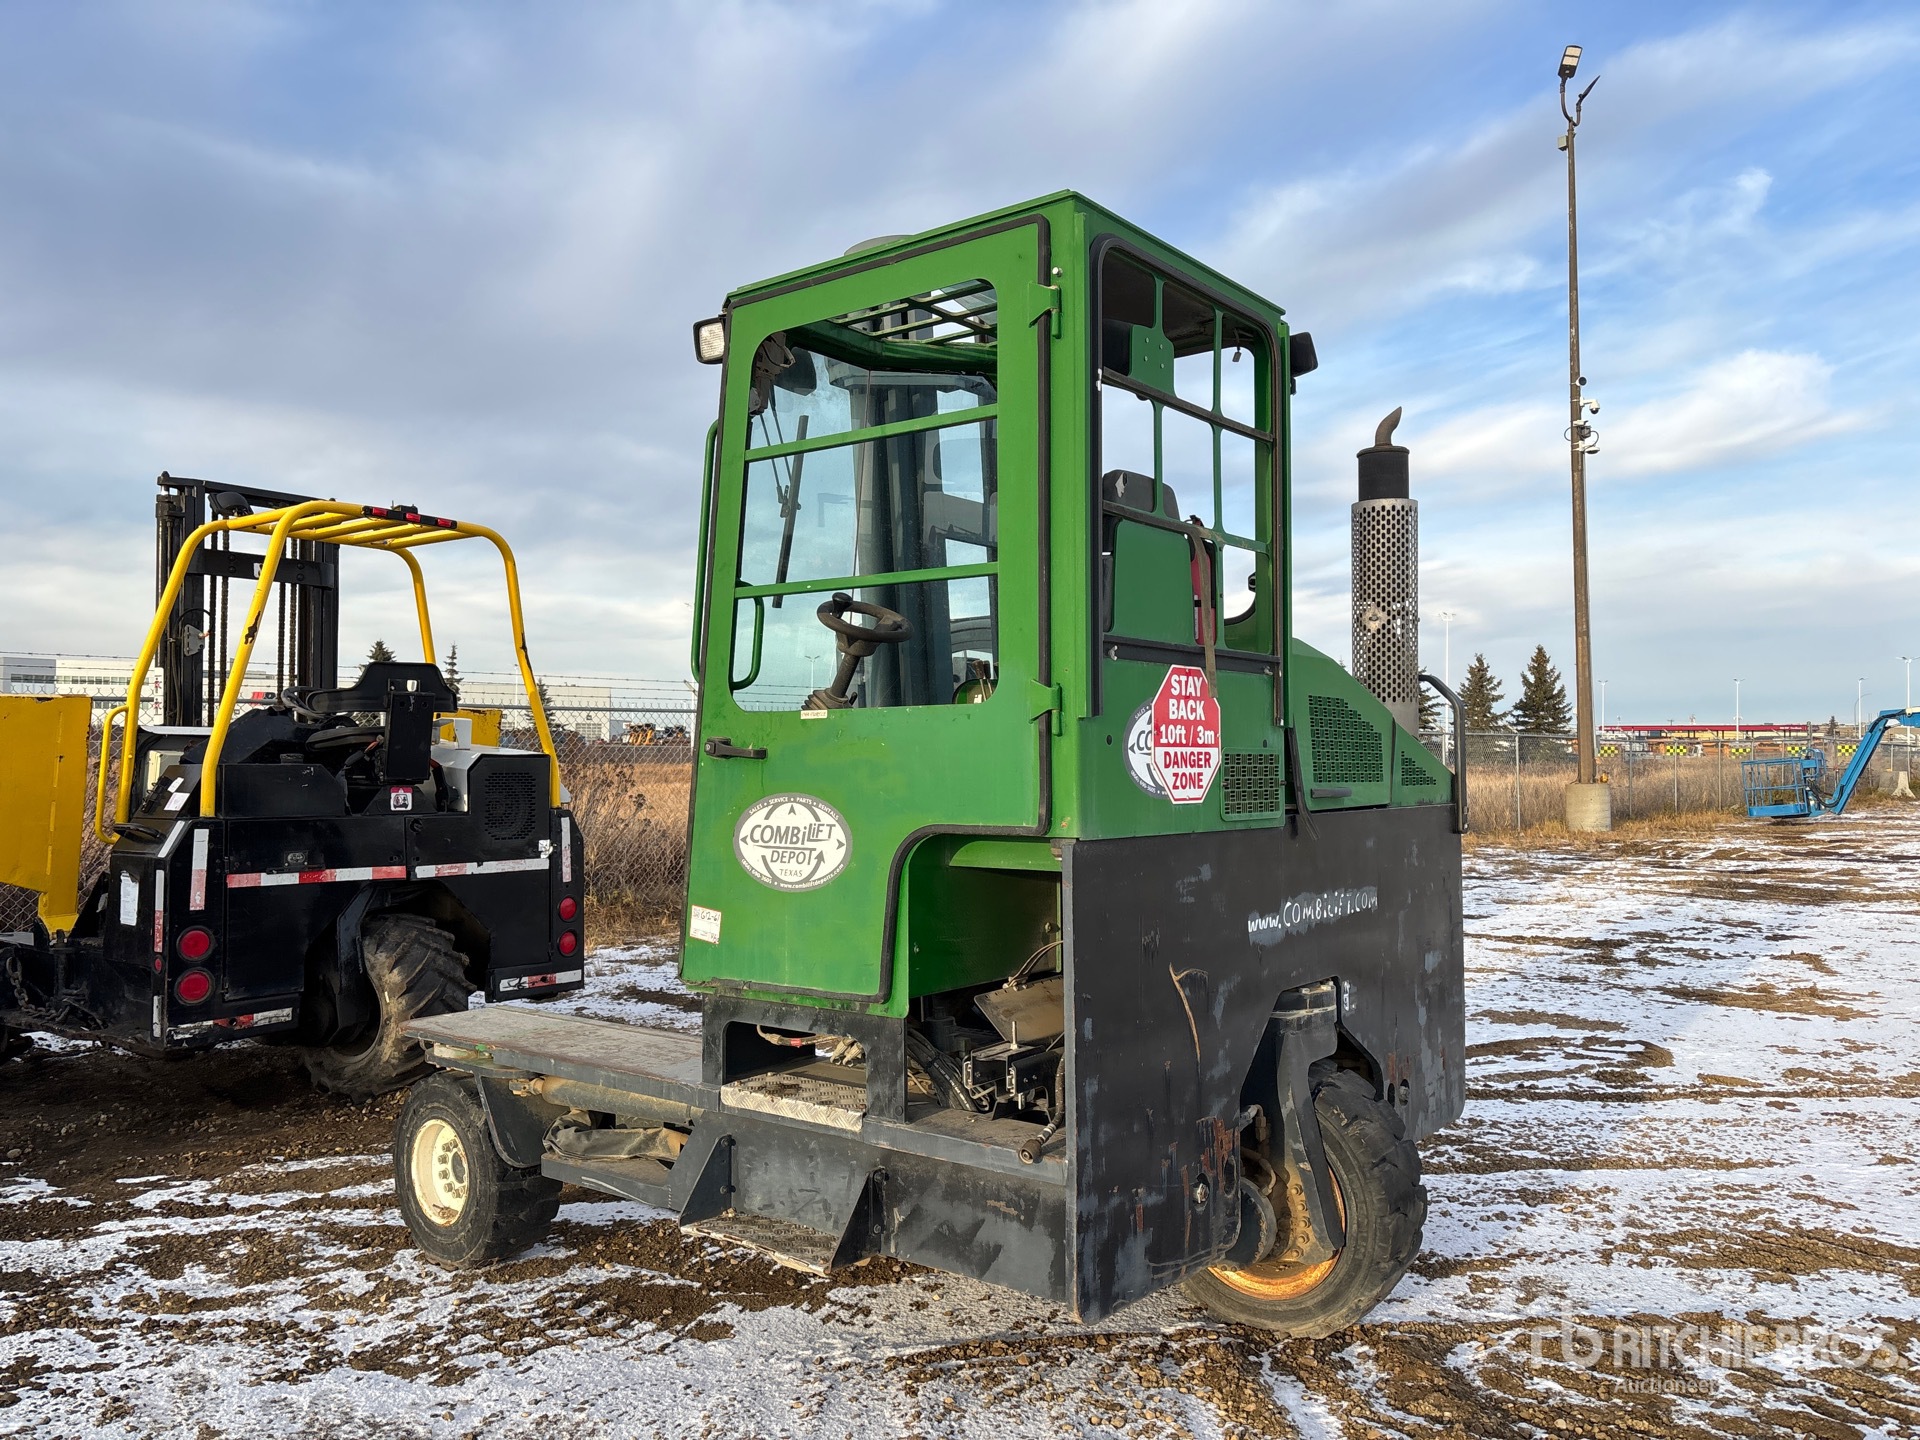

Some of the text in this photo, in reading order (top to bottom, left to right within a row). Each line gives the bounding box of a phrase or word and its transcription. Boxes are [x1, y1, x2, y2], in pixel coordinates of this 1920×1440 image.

[1170, 674, 1203, 697] STAY
[1168, 698, 1206, 721] BACK
[1159, 724, 1187, 744] 10ft
[1188, 725, 1195, 746] /
[1196, 727, 1215, 745] 3m
[1163, 751, 1212, 769] DANGER
[1172, 772, 1204, 790] ZONE
[748, 796, 839, 820] SALES SERVICE PARTS RENTALS
[770, 847, 817, 866] DEPOT
[779, 868, 803, 877] TEXAS
